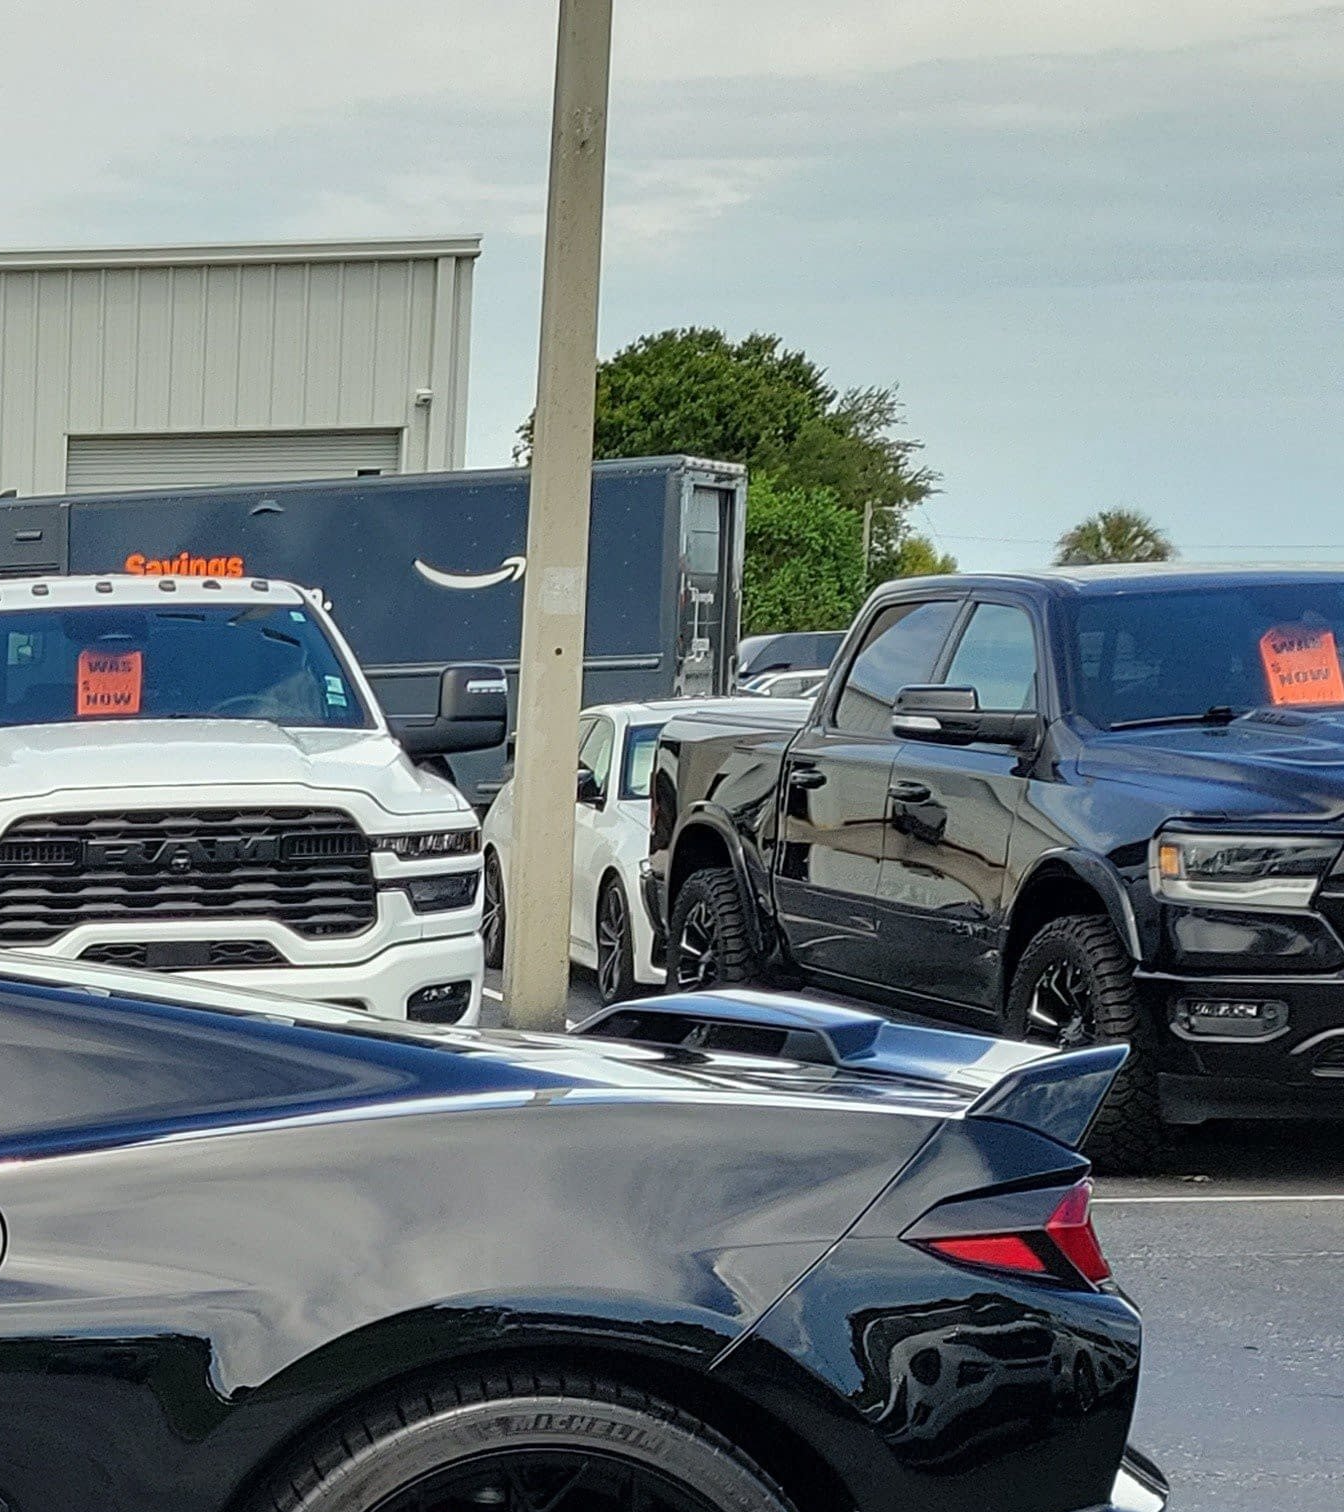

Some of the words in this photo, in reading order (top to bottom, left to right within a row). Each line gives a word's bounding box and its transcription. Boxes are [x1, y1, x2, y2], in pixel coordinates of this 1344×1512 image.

[124, 551, 244, 577] Savings
[1279, 668, 1329, 687] NOW
[86, 692, 132, 705] NOW
[87, 836, 280, 864] RAM
